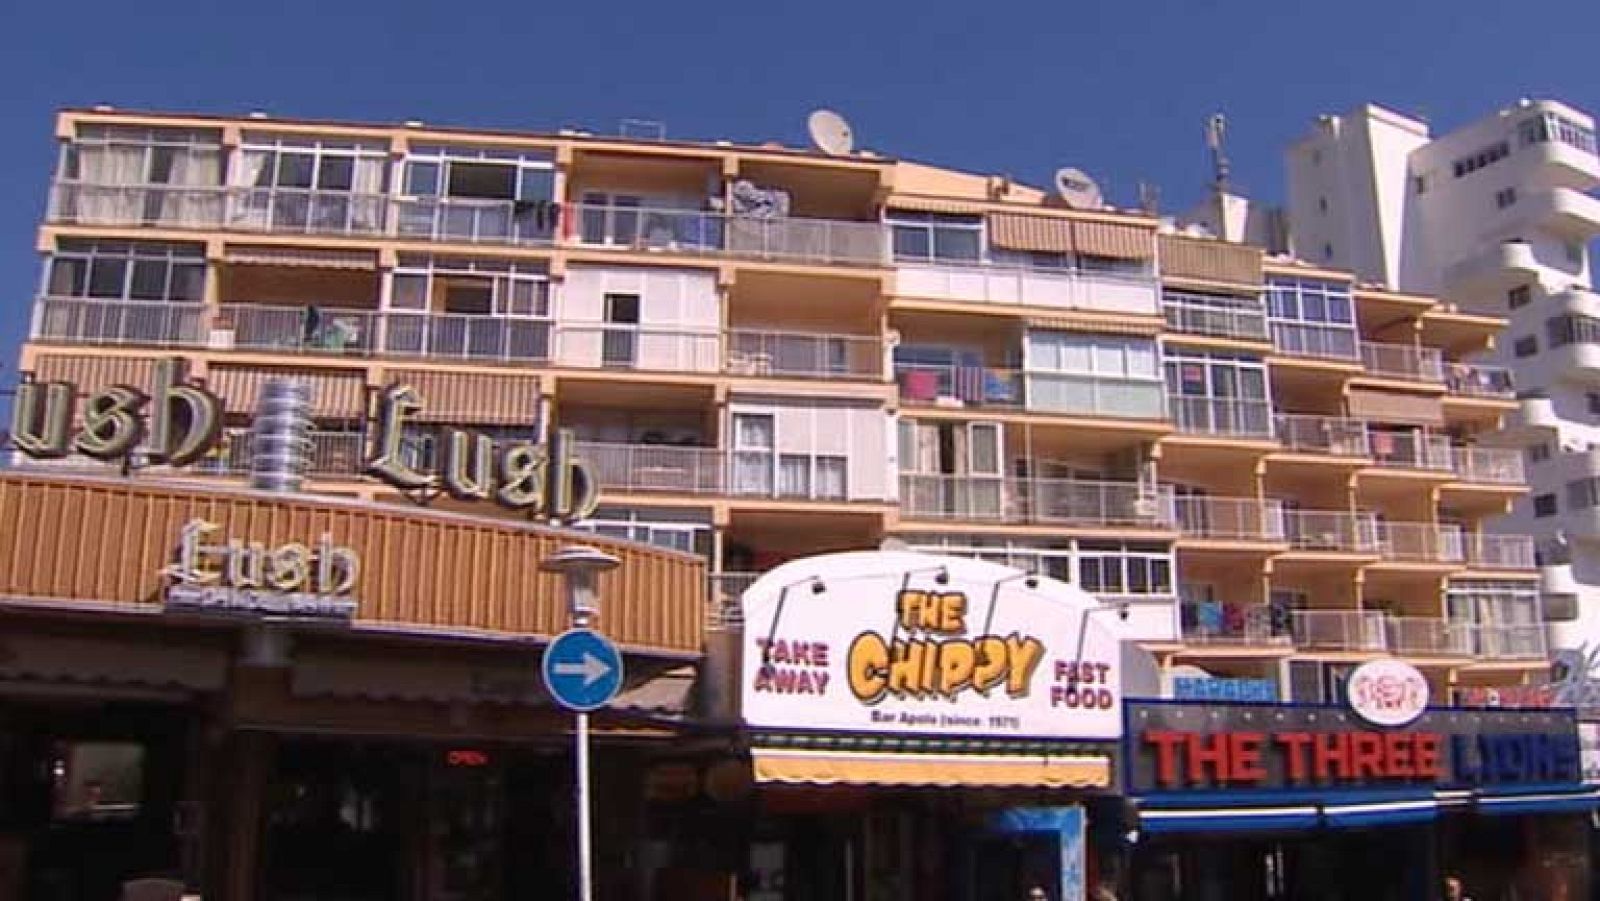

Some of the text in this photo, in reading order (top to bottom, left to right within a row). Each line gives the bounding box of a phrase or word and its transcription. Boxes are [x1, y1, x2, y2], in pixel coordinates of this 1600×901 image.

[368, 385, 600, 520] Lush
[158, 519, 361, 596] Lush
[897, 589, 967, 635] THE
[756, 638, 829, 667] TAKE
[847, 630, 1046, 706] CHIPPY
[1053, 660, 1110, 685] FAST
[754, 666, 829, 695] AWAY
[1051, 685, 1113, 711] FOOD
[1145, 730, 1267, 783] THE
[1275, 731, 1444, 782] THREE
